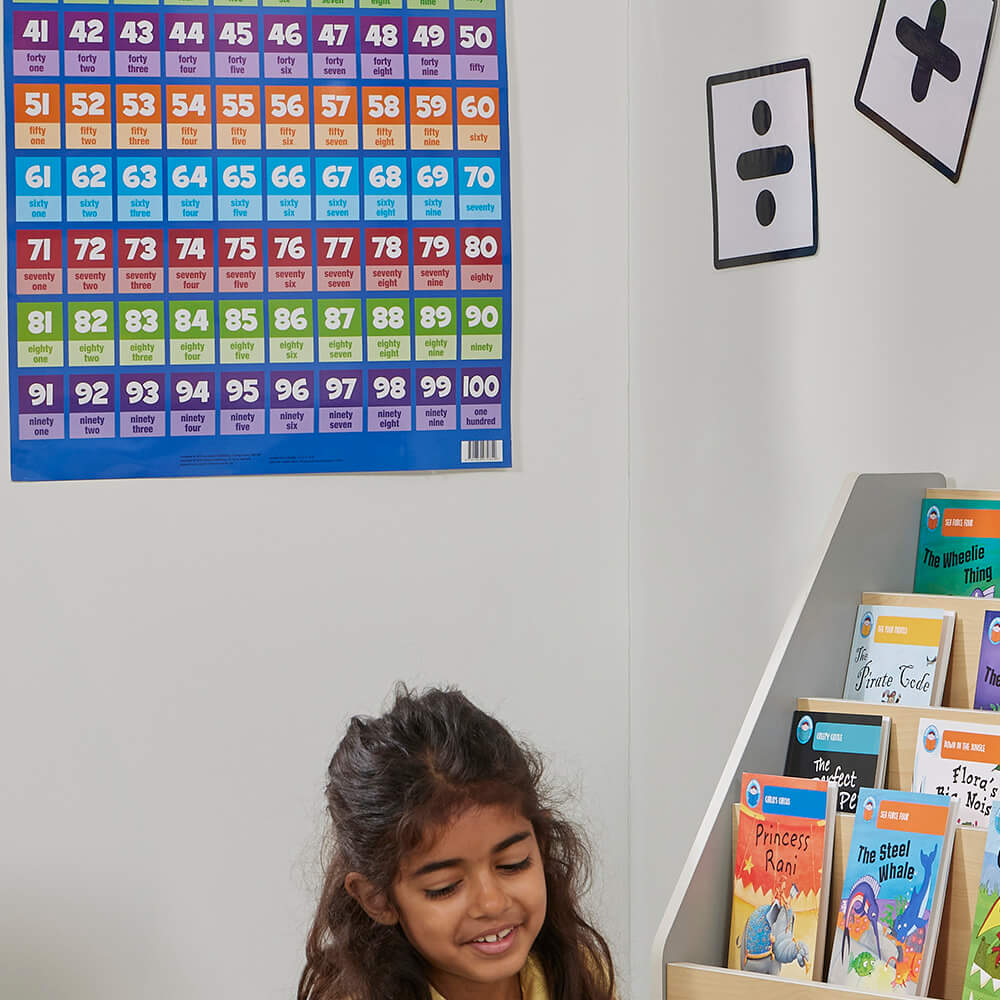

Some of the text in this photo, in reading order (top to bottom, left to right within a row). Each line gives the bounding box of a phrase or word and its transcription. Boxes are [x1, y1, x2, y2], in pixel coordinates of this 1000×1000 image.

[219, 22, 253, 45] 45
[413, 25, 444, 47] 49
[228, 56, 246, 65] forty
[231, 65, 244, 73] five
[421, 58, 438, 67] forty
[422, 67, 438, 75] nine
[72, 92, 105, 116] 52
[461, 96, 495, 118] 60
[81, 127, 96, 136] fifty
[470, 133, 488, 143] sixty
[123, 165, 156, 188] 63
[130, 209, 150, 217] three
[131, 199, 150, 208] sixty
[28, 239, 50, 260] 71
[324, 236, 352, 259] 77
[24, 272, 55, 282] seventy
[324, 269, 354, 279] seventy
[75, 309, 107, 333] 82
[466, 305, 498, 328] 90
[80, 344, 104, 354] eighty
[471, 343, 493, 352] ninety
[84, 354, 99, 362] two
[176, 381, 209, 402] 94
[463, 375, 499, 397] 100
[181, 414, 205, 423] ninety
[185, 424, 201, 432] four
[466, 417, 495, 425] hundred
[923, 544, 985, 569] The Wheelie
[964, 565, 993, 585] Thing
[855, 646, 870, 664] The
[855, 660, 930, 693] Pirate Code
[813, 756, 831, 773] The
[952, 764, 999, 798] Flora's
[755, 823, 811, 852] Princess
[857, 840, 911, 864] The Steel
[765, 849, 798, 876] Rani
[878, 861, 915, 883] Whale
